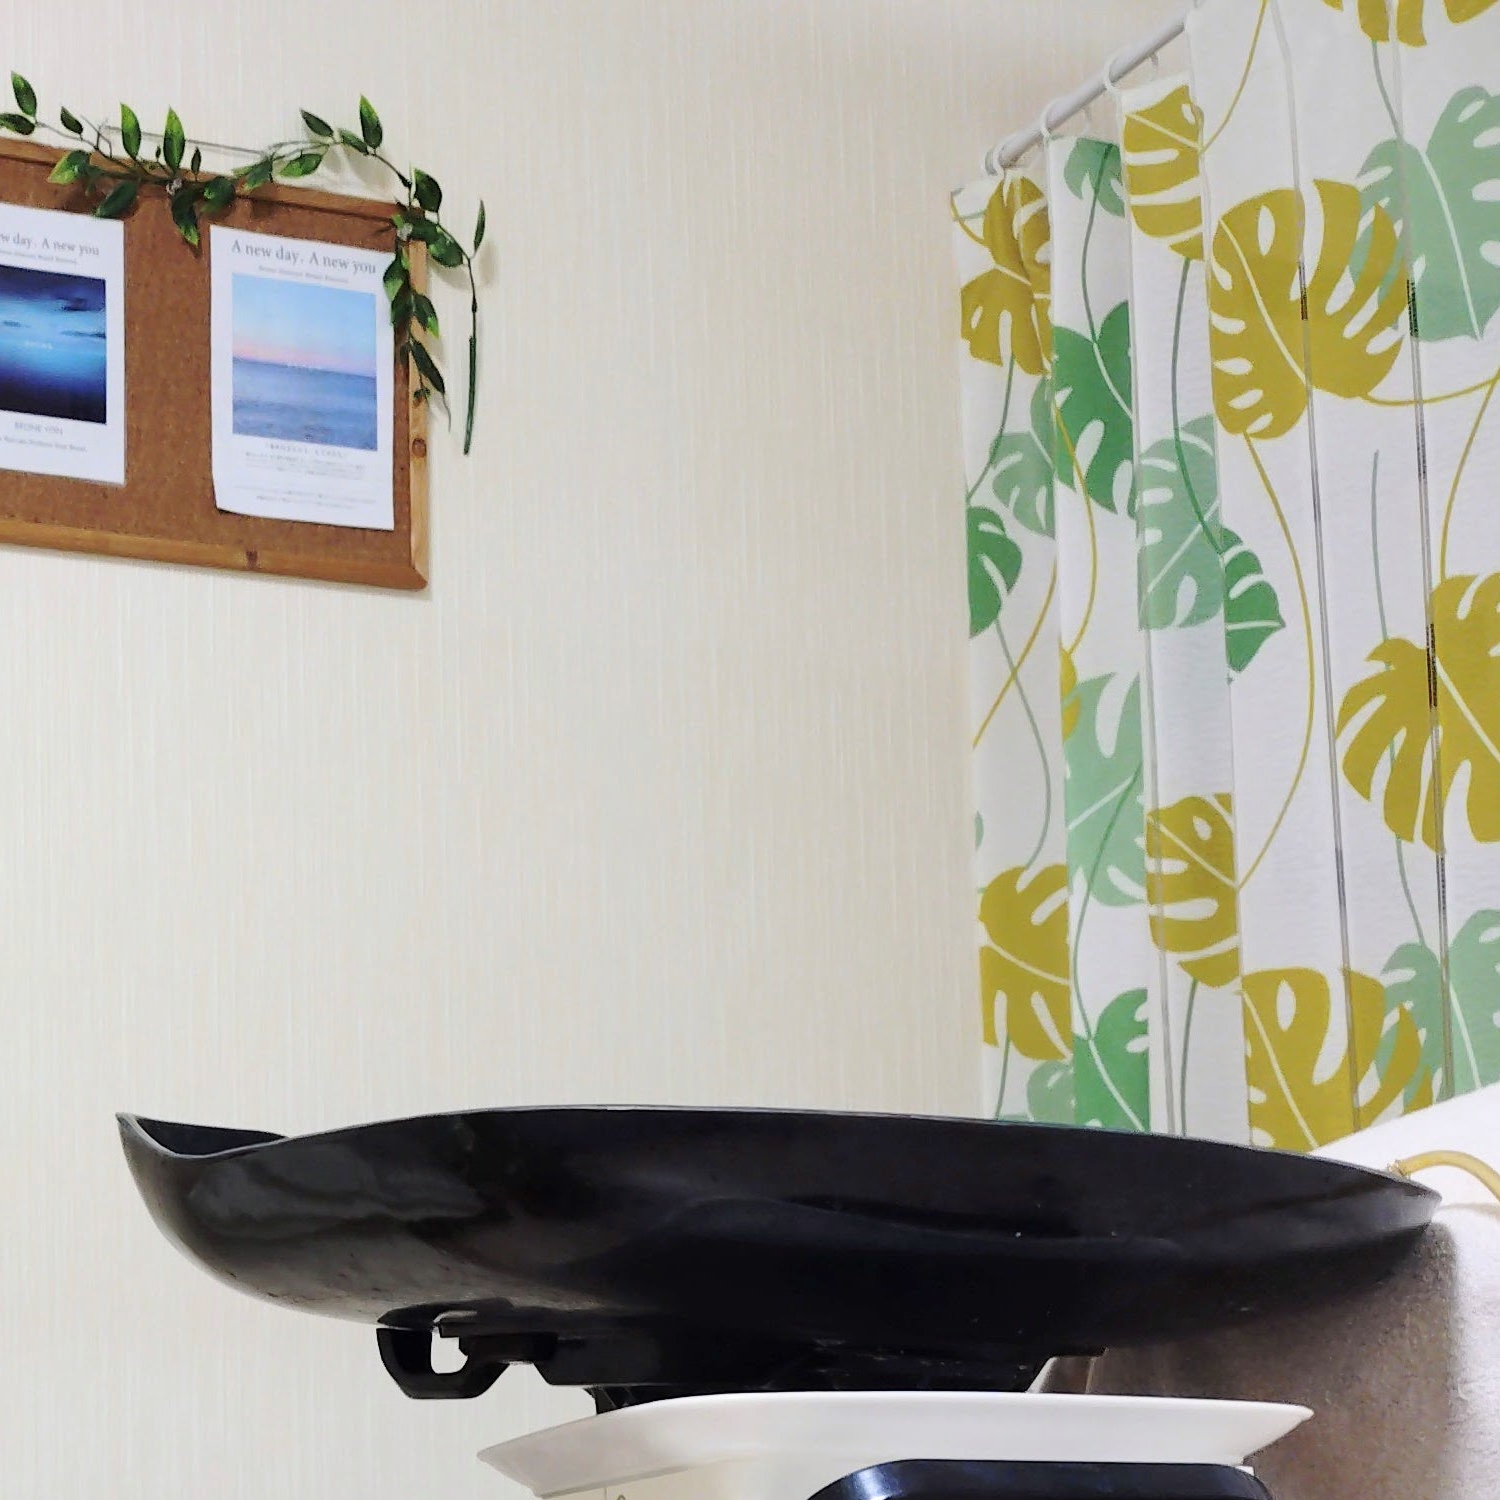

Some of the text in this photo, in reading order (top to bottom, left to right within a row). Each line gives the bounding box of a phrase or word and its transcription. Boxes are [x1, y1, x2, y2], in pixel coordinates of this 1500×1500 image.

[53, 241, 76, 252] new
[79, 244, 100, 257] you
[232, 239, 241, 254] A
[245, 246, 271, 259] new
[309, 251, 319, 266] A
[323, 255, 350, 269] new
[352, 259, 376, 275] you
